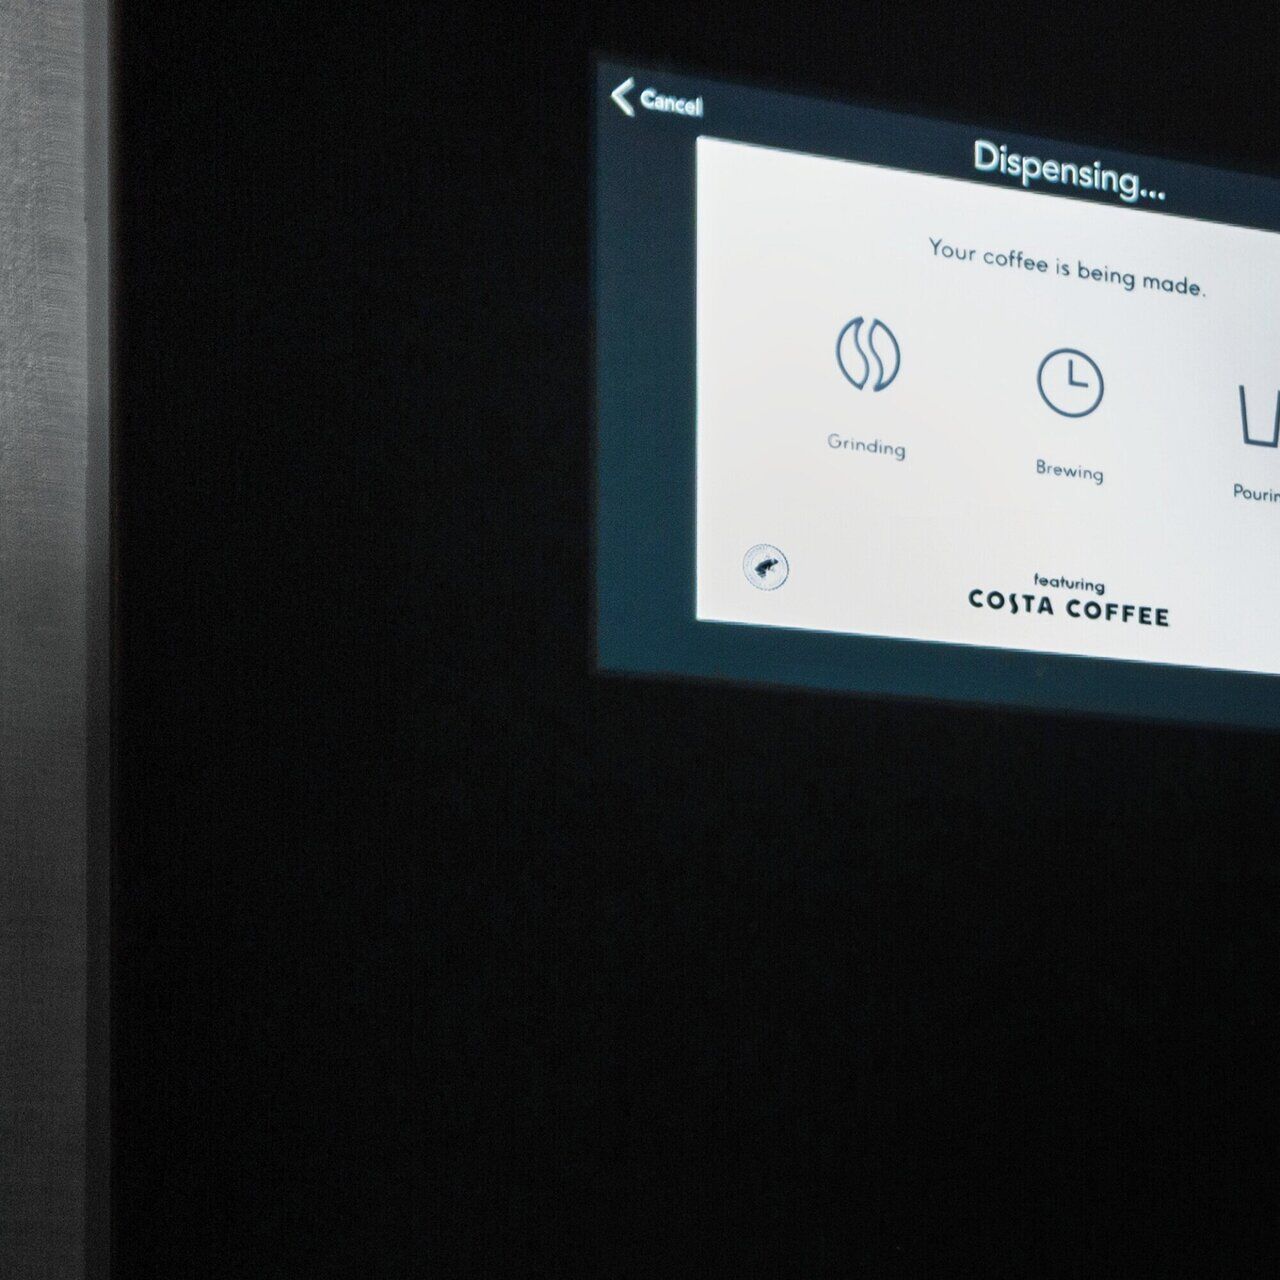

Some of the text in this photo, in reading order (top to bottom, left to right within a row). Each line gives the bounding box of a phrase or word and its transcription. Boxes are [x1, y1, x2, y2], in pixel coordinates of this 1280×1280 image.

[640, 87, 704, 118] Cancel
[974, 139, 1166, 202] Dispensing...
[929, 236, 1206, 298] Your coffee is being made.
[827, 432, 907, 462] Grinding
[1035, 459, 1104, 486] Brewing
[1033, 572, 1106, 596] featuring
[968, 587, 1170, 628] COSTA COFFEE
